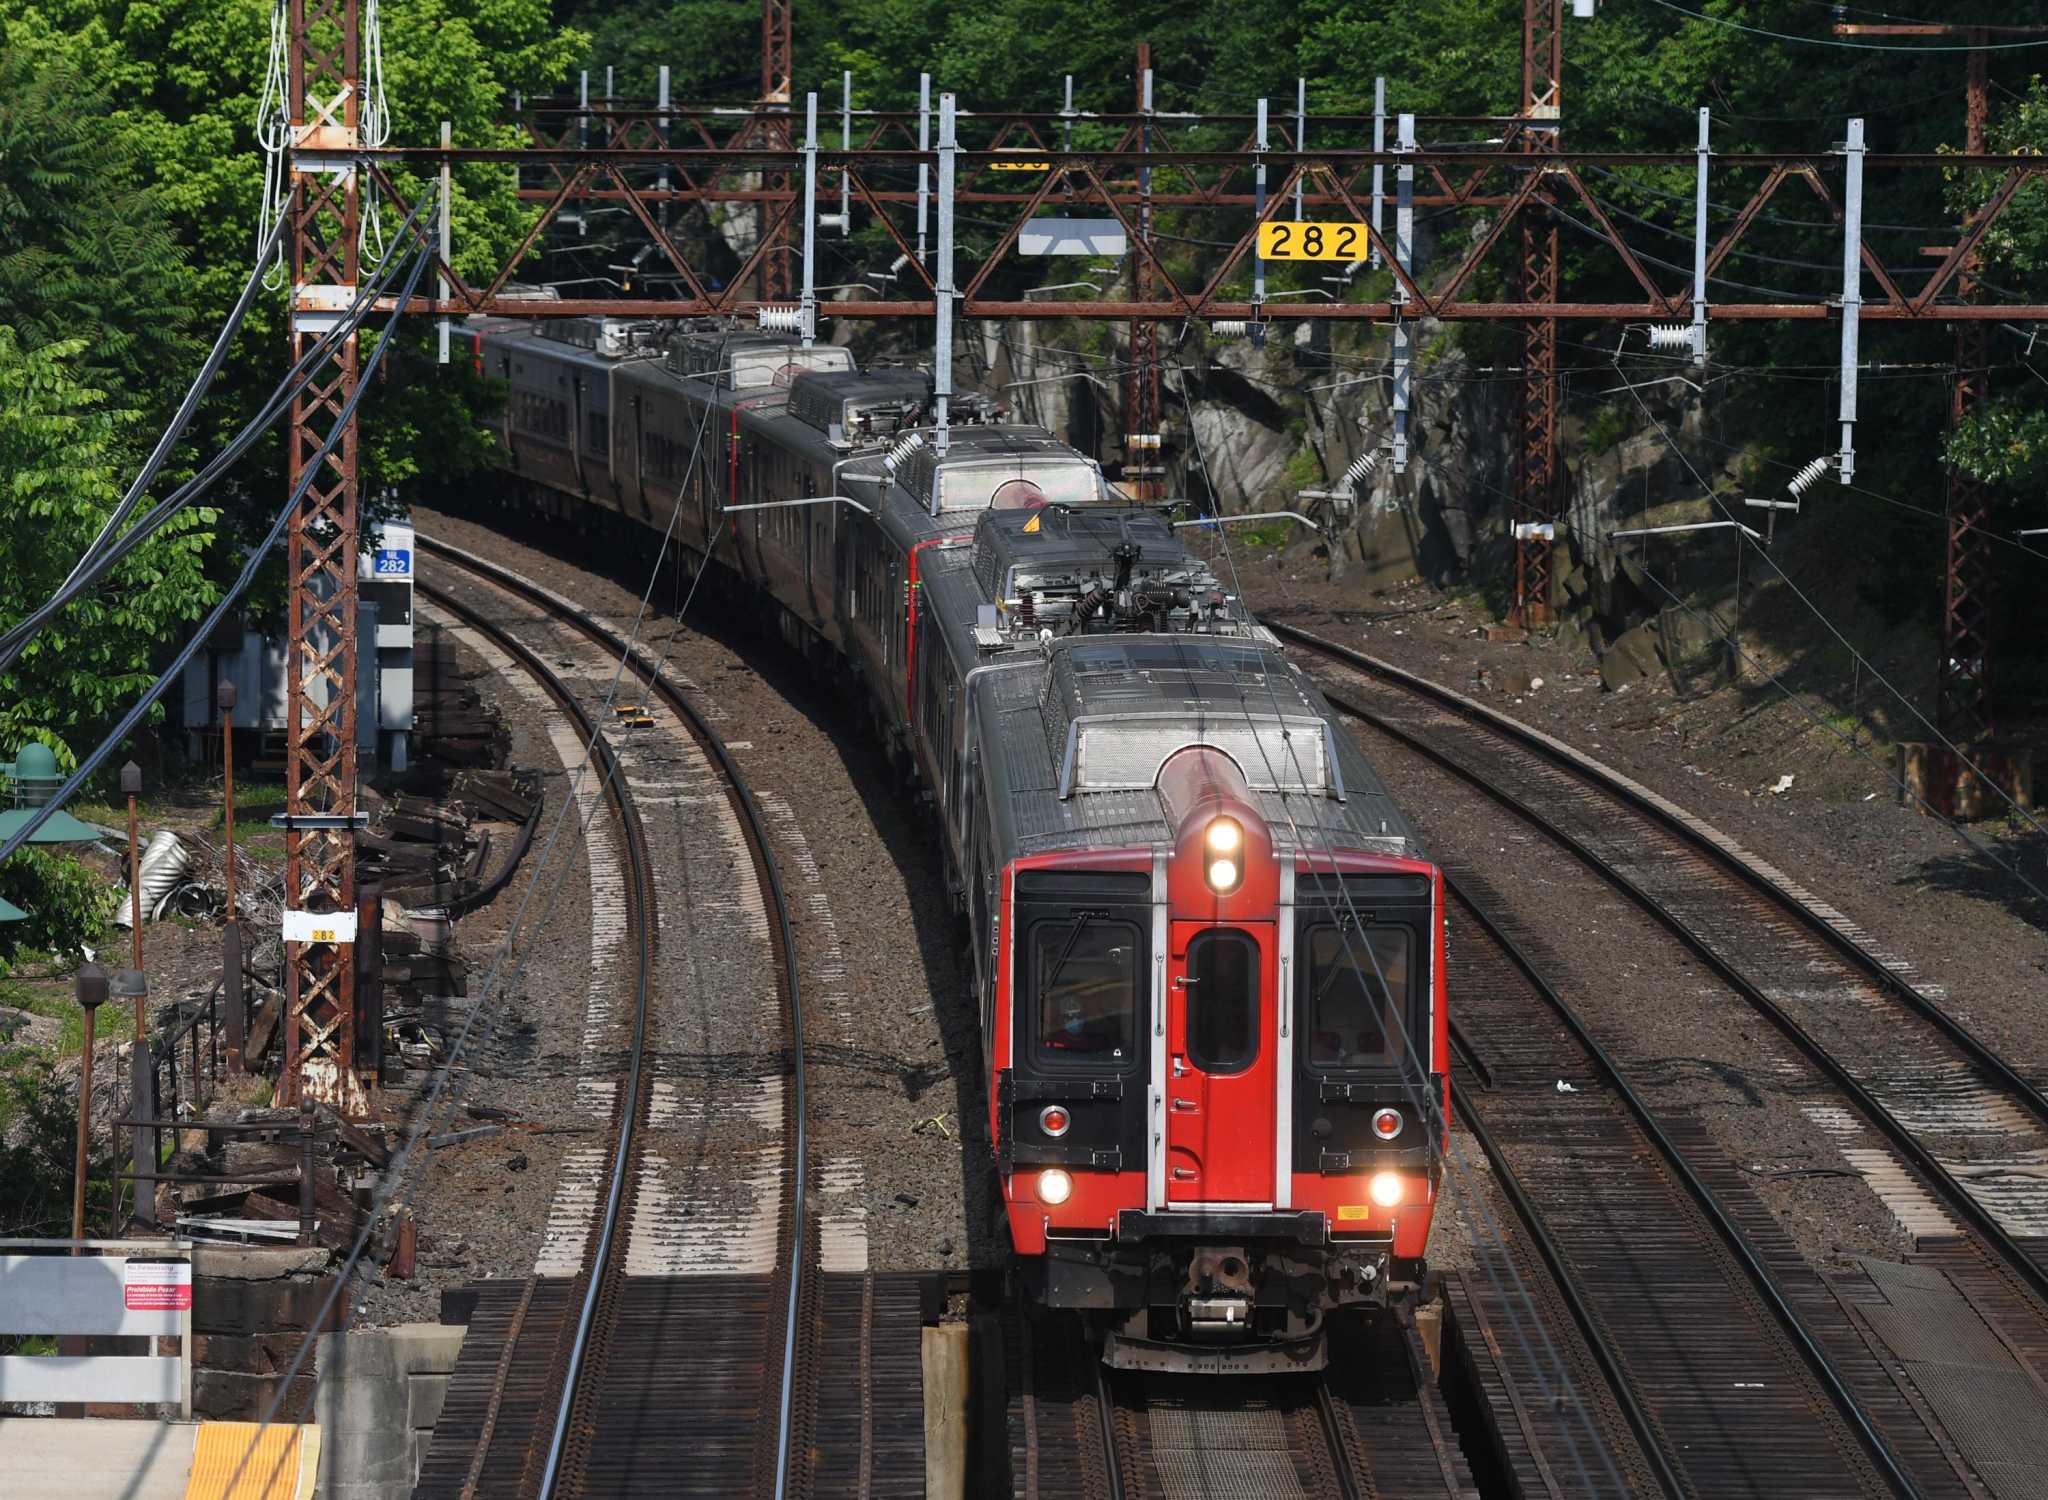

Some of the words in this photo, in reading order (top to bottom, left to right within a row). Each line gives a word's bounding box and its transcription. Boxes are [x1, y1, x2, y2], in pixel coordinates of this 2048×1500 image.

[1271, 225, 1357, 257] 282
[380, 559, 406, 572] 282
[313, 930, 335, 941] 282
